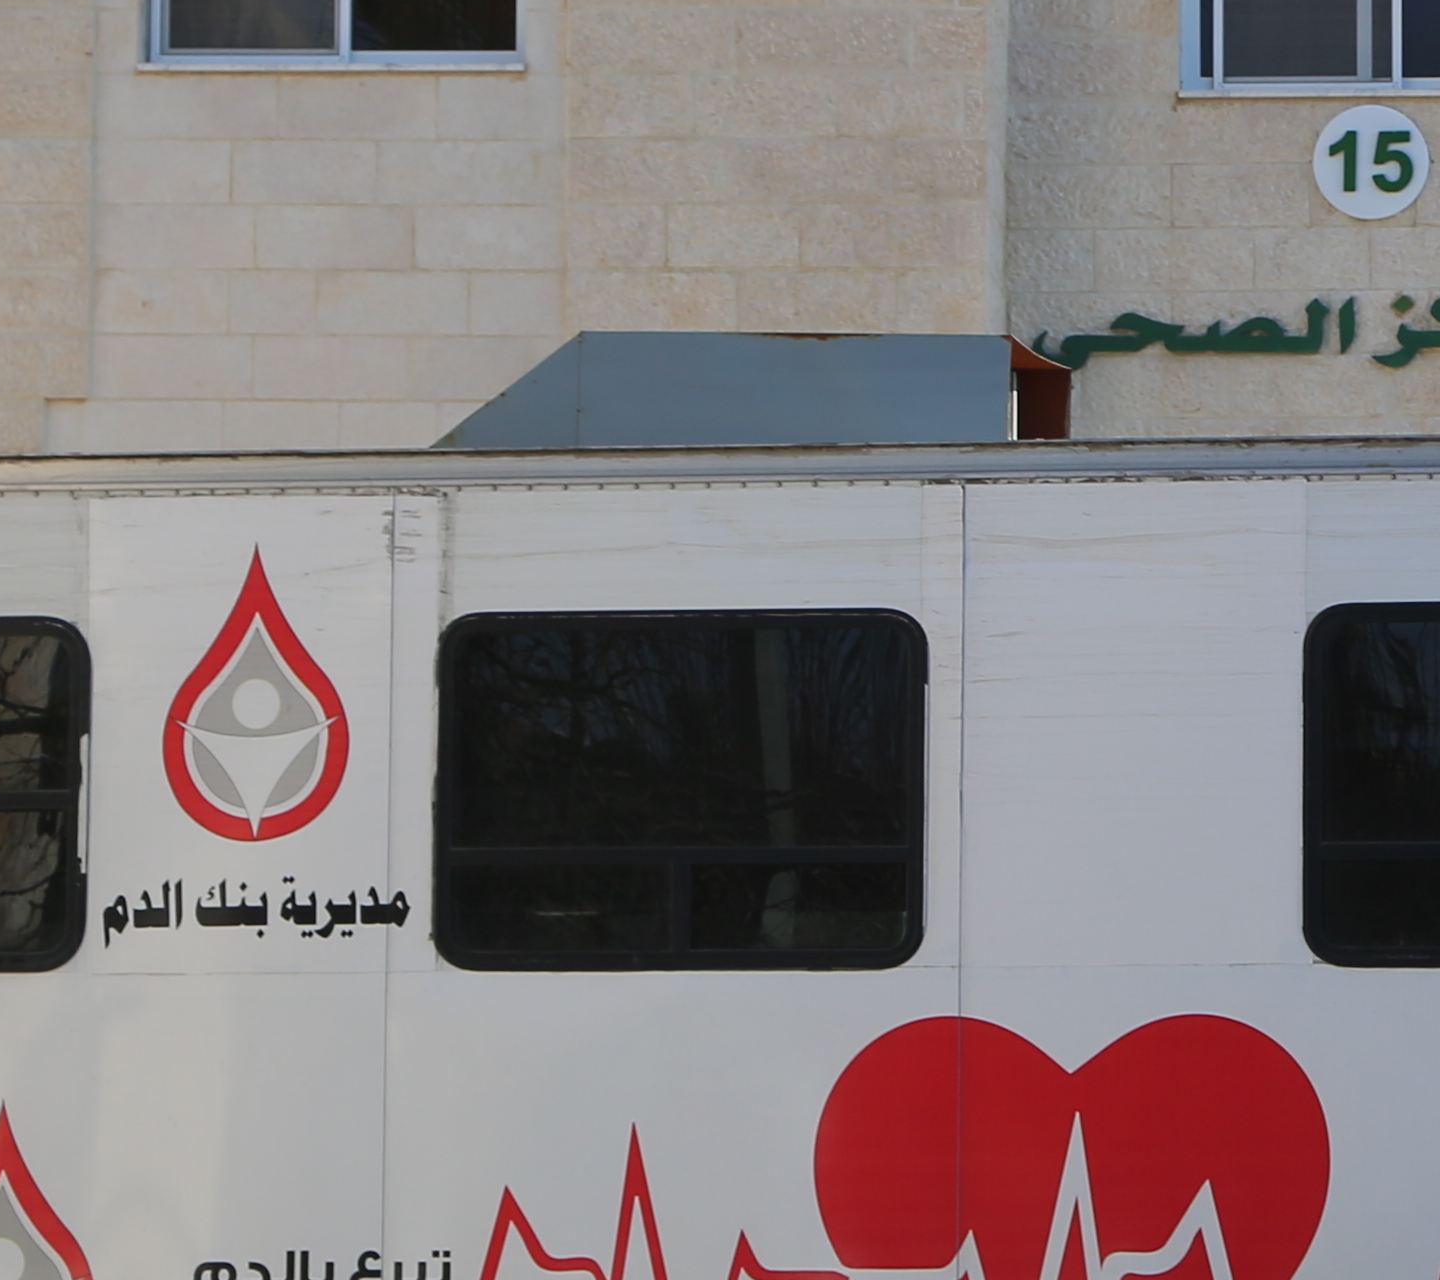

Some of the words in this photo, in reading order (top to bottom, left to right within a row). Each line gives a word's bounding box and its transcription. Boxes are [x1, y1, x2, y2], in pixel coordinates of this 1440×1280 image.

[1329, 130, 1414, 192] 15
[103, 880, 183, 948] الدم
[195, 879, 268, 939] بنك
[279, 876, 411, 939] مديرية
